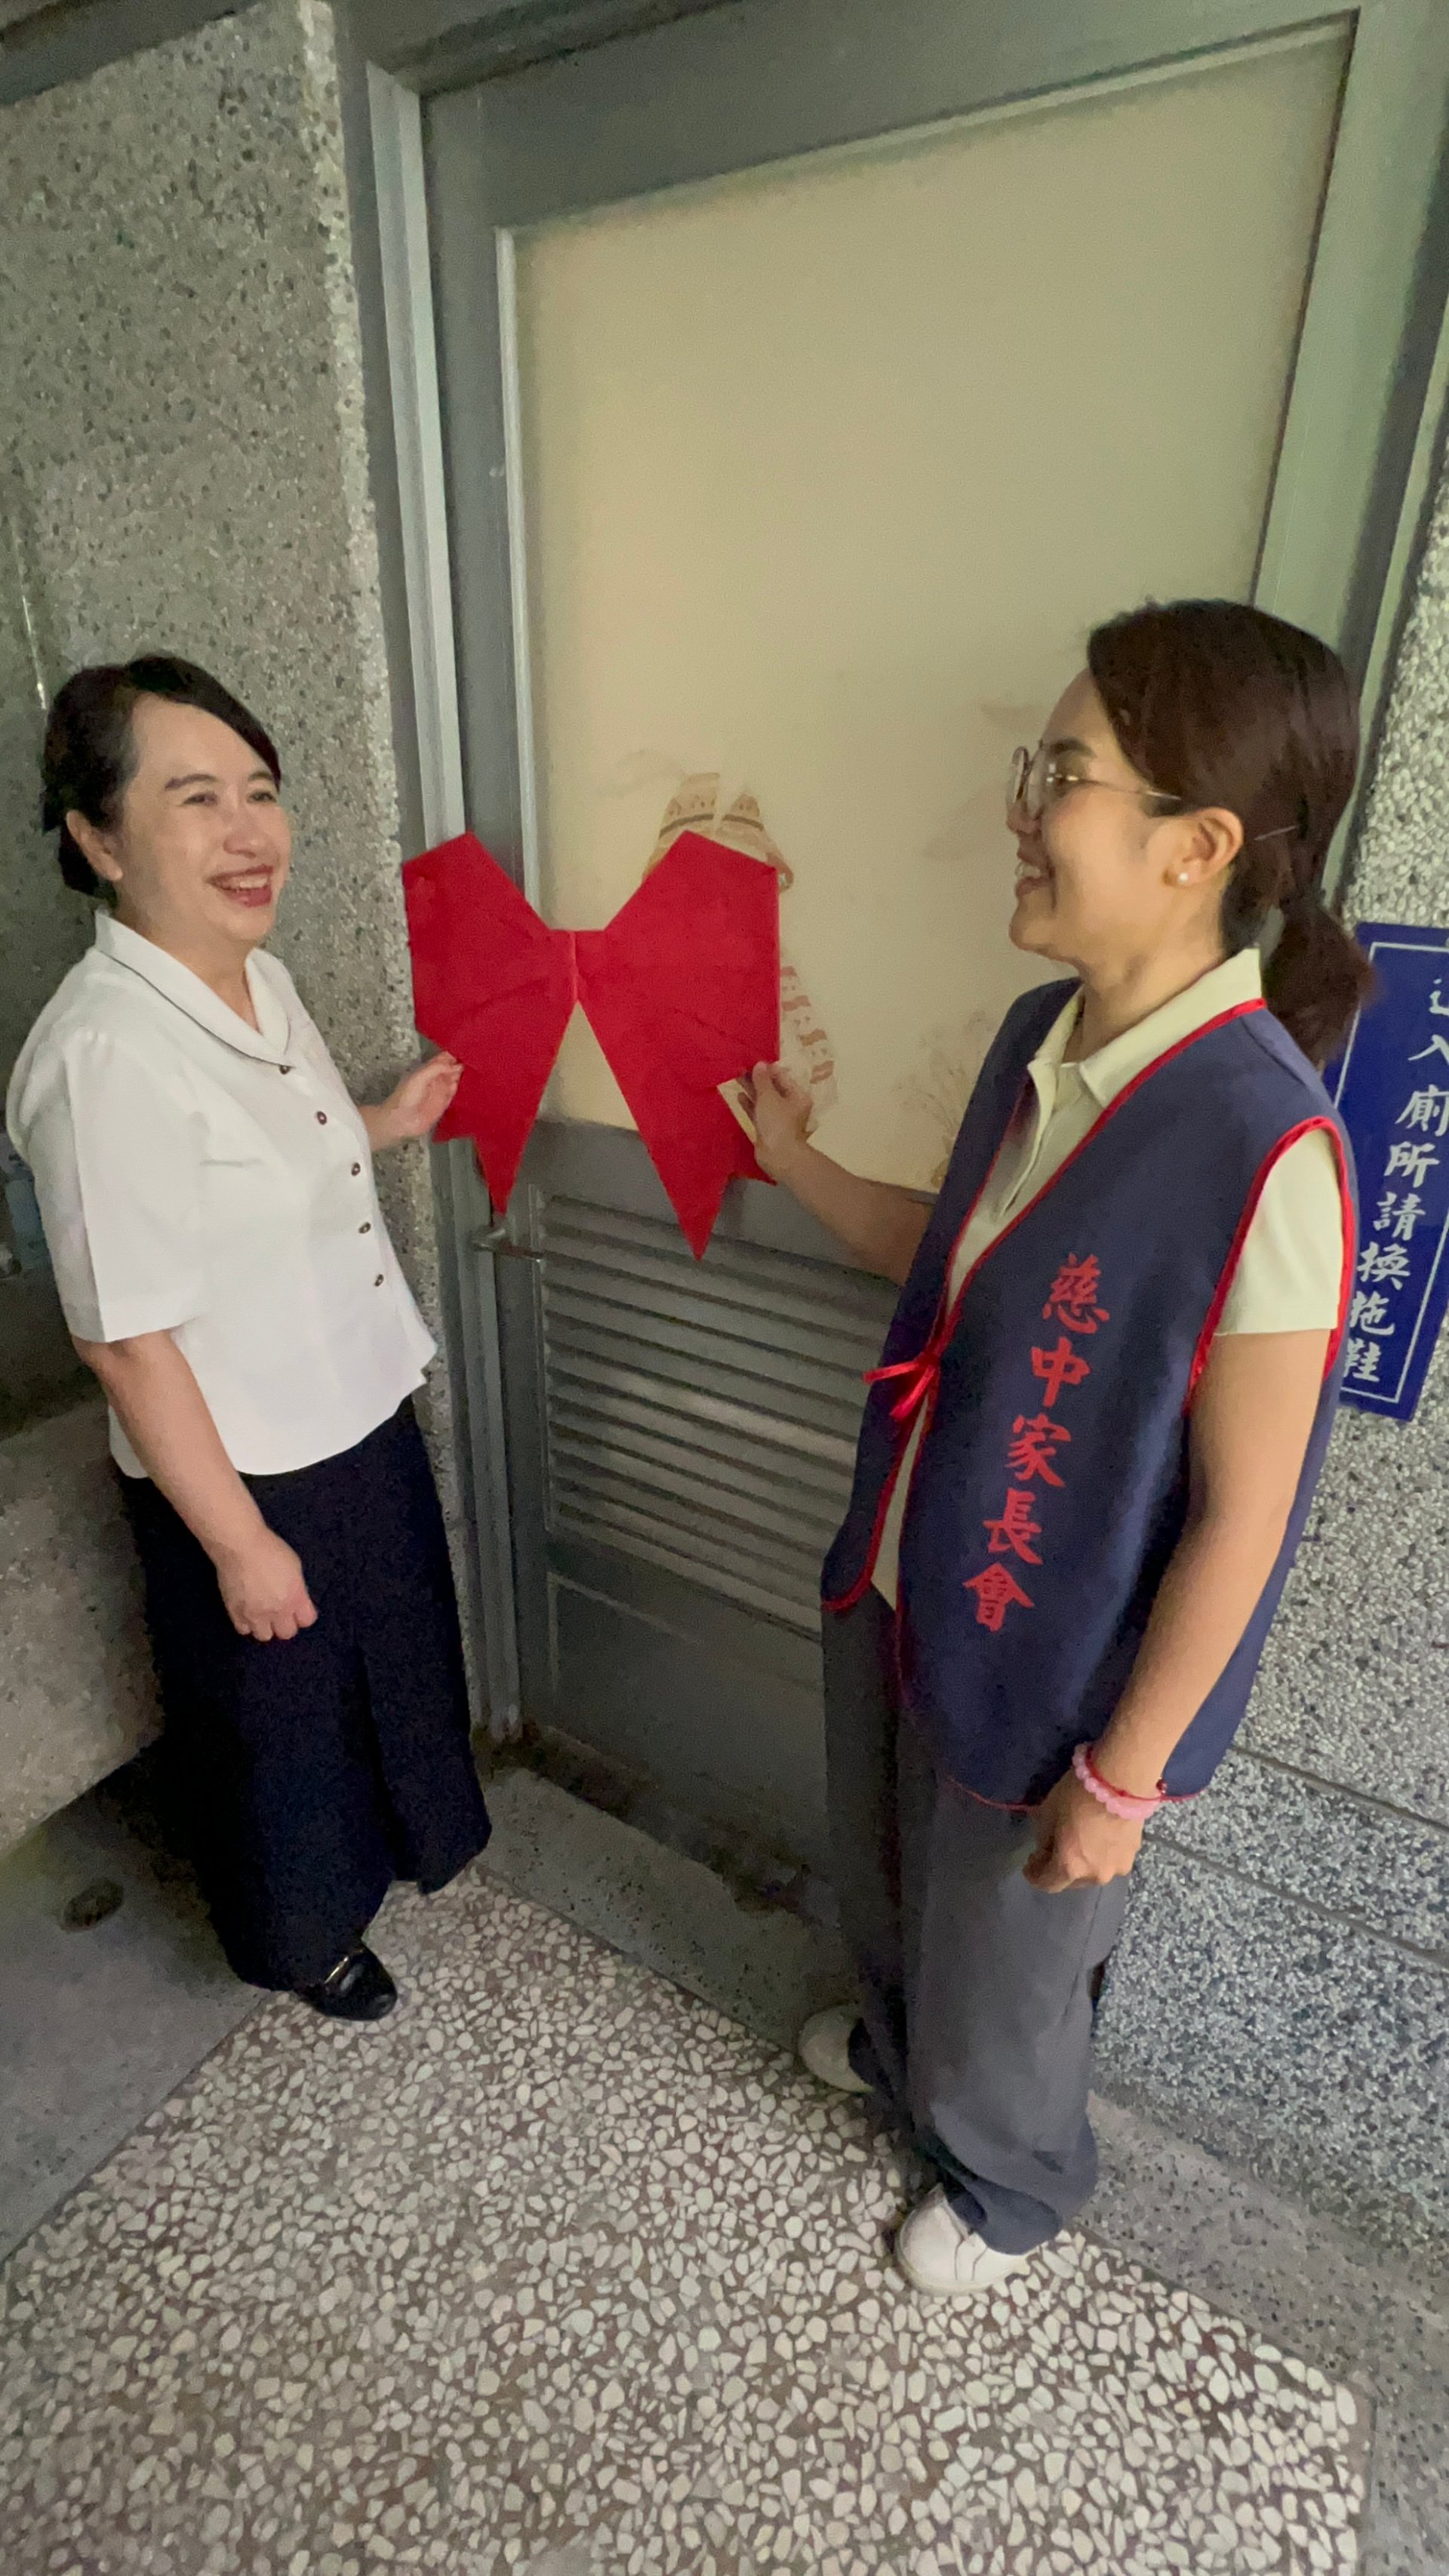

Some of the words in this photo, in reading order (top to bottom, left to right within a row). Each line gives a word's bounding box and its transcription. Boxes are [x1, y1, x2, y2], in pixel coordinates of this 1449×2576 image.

[962, 1252, 1110, 1633] 慈中家長會
